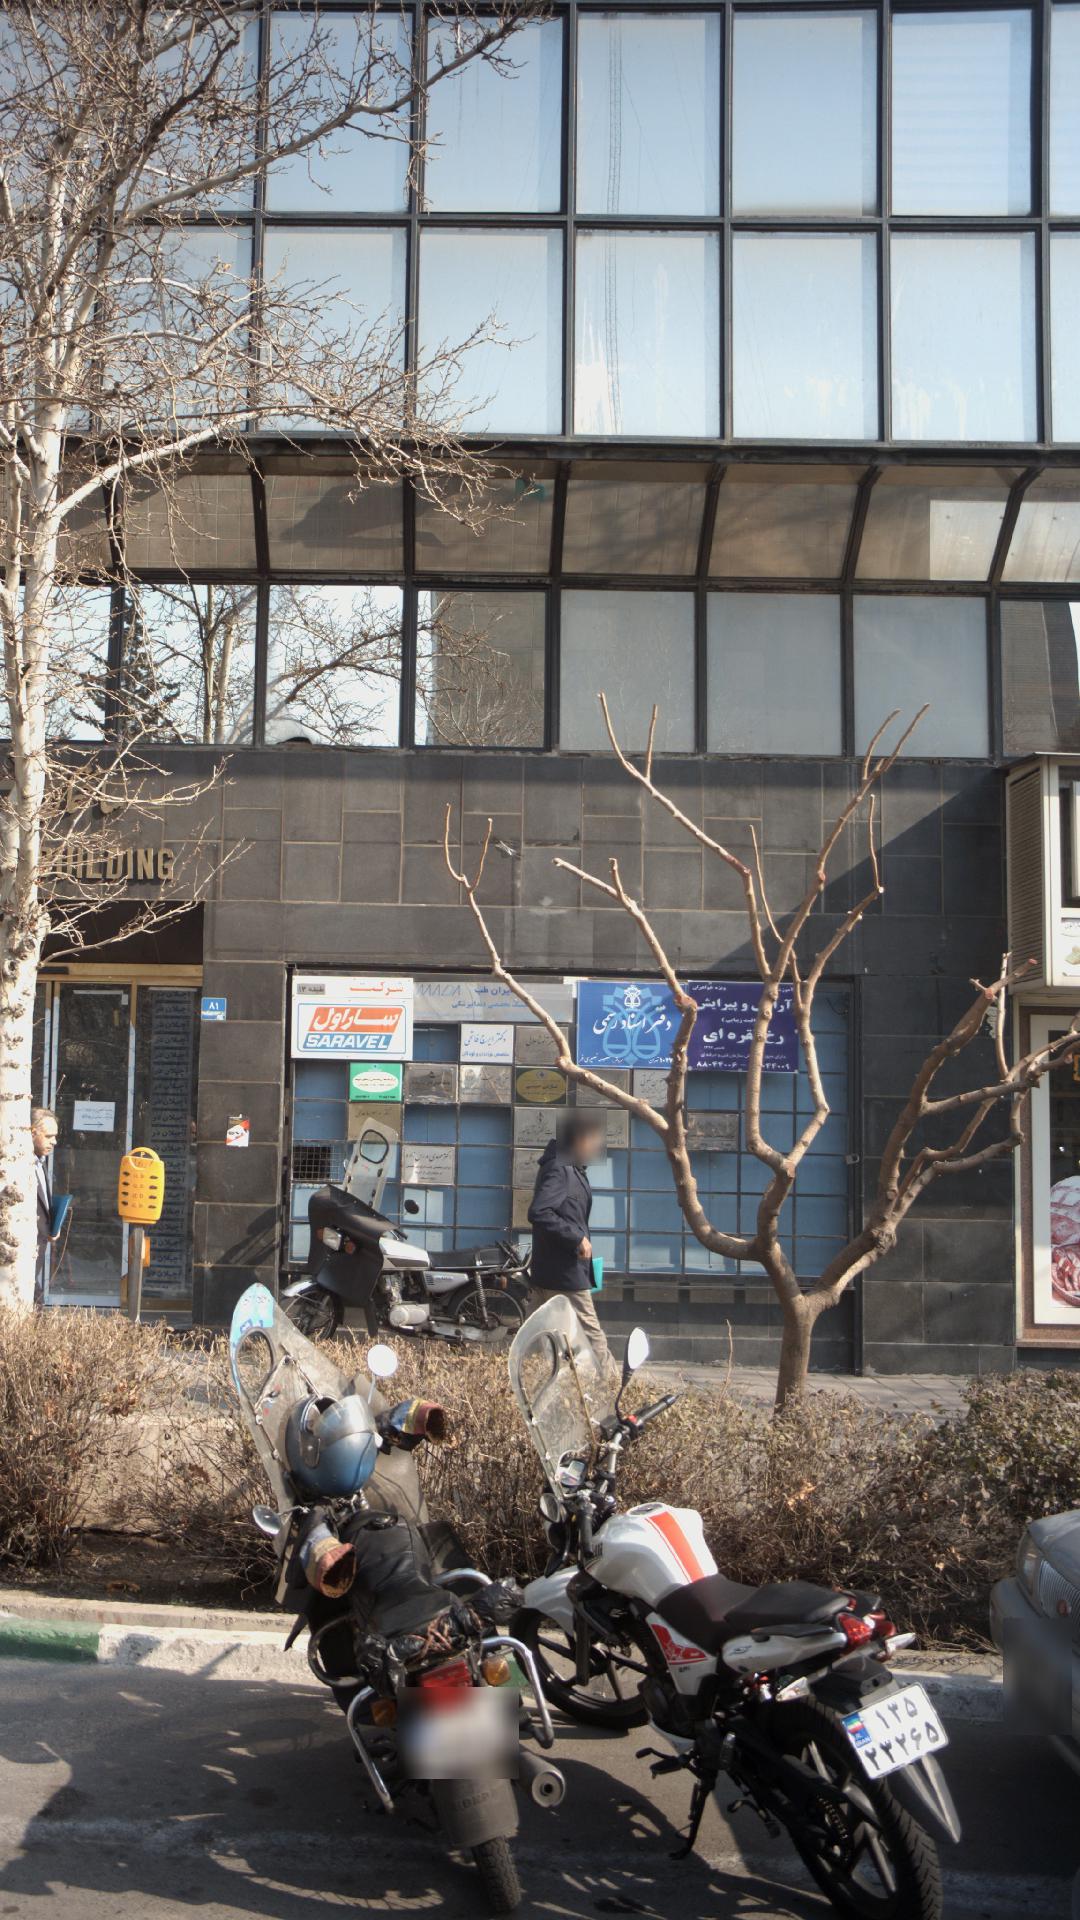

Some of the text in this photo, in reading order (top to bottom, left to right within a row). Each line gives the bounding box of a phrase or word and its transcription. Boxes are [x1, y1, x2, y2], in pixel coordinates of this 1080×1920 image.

[313, 1007, 399, 1031] ساراول
[593, 1005, 672, 1035] دفتر اسناد رسمی
[306, 1034, 388, 1049] SARAVEL
